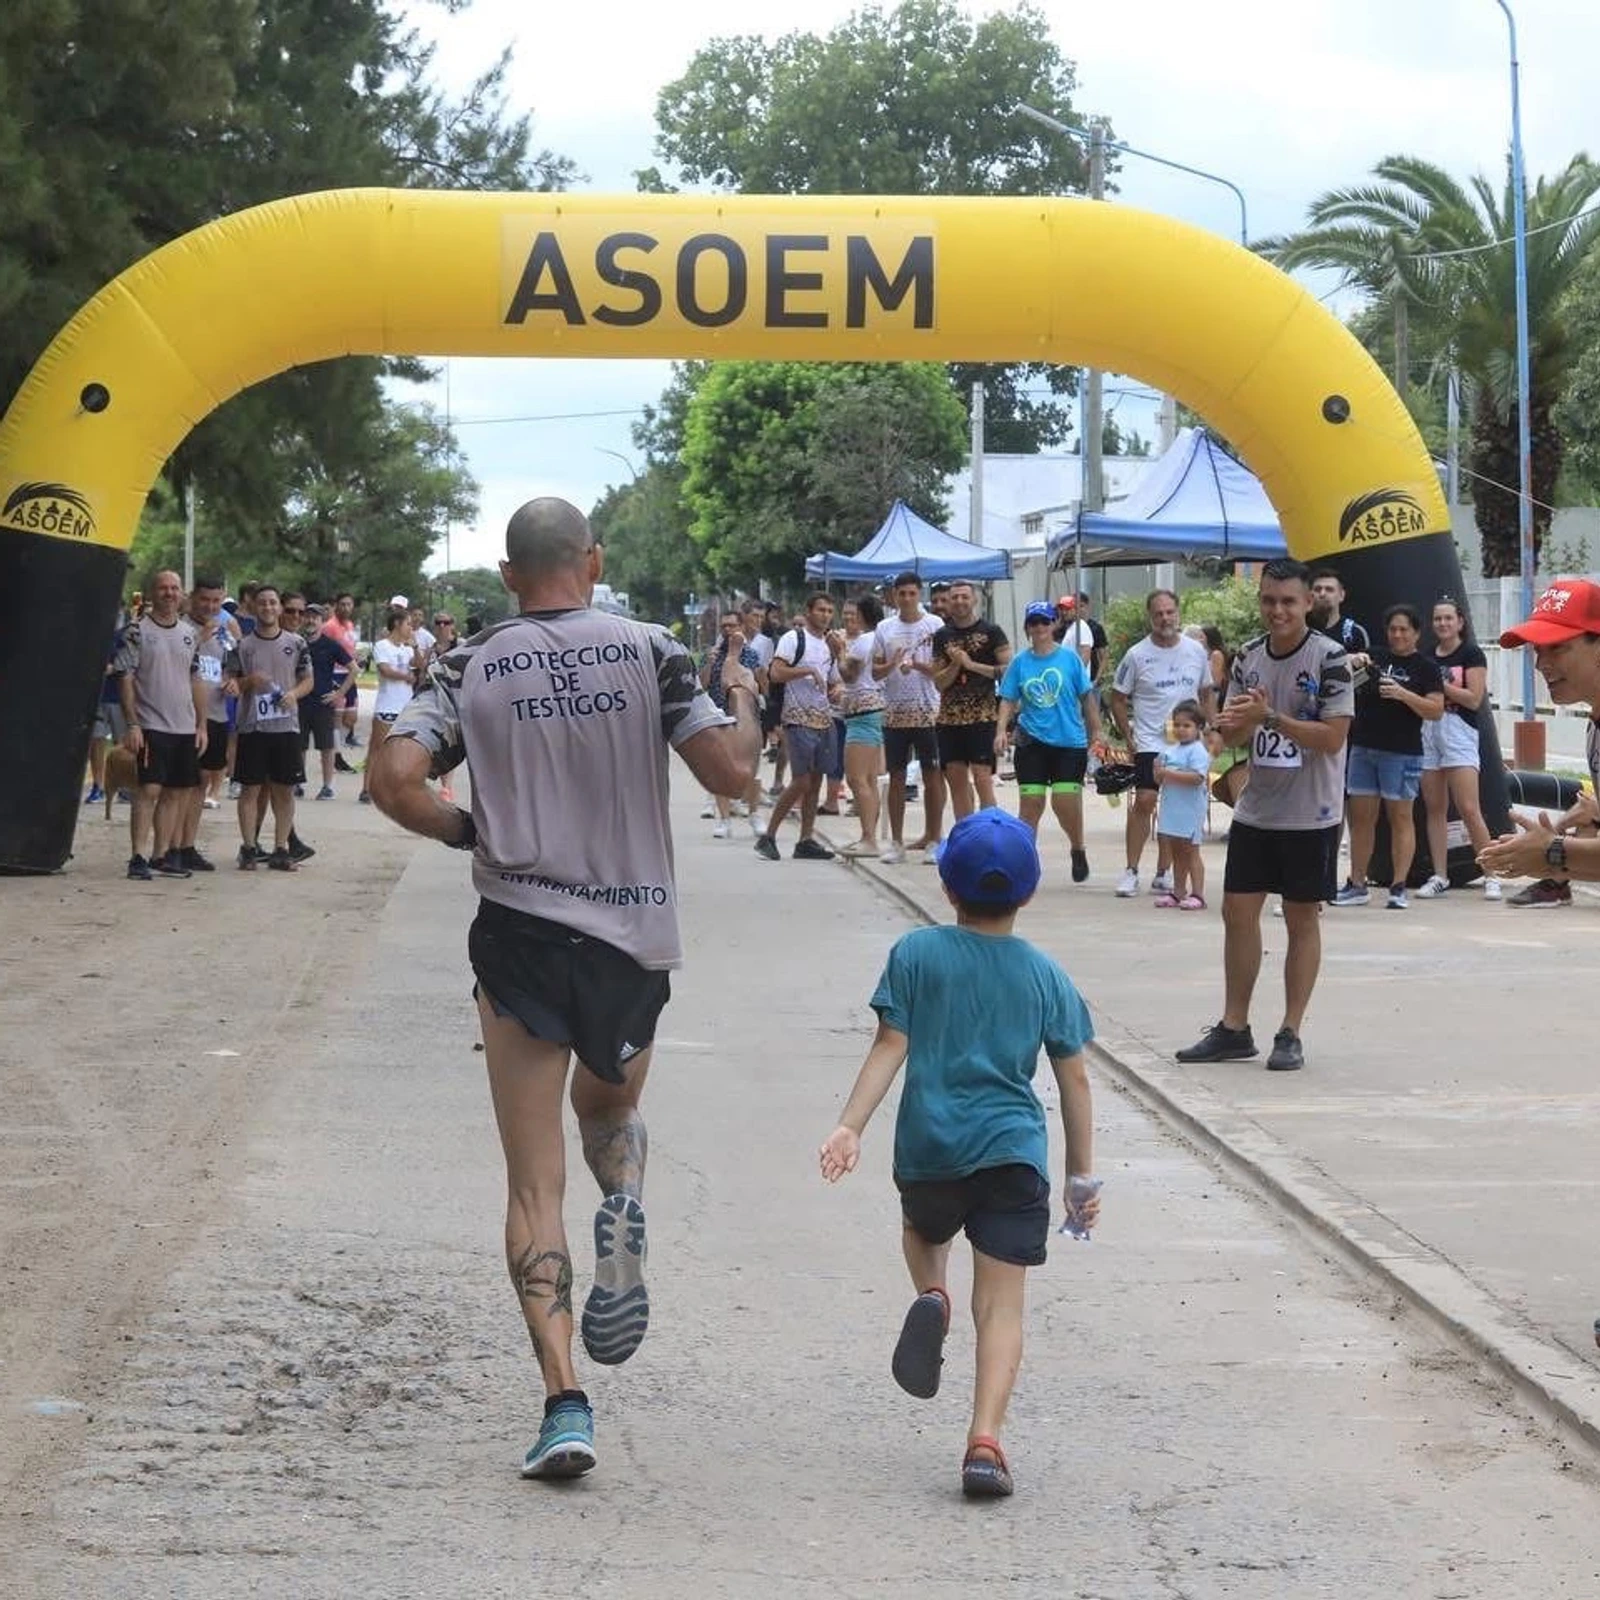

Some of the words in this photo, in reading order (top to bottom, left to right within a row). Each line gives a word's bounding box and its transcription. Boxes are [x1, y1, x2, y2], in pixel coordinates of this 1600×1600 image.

[503, 231, 934, 329] ASOEM
[10, 507, 91, 538] ASOEM
[1351, 512, 1425, 543] ASOEM
[483, 643, 640, 682] PROTECCION
[550, 672, 582, 693] DE
[511, 690, 628, 721] TESTIGOS
[1256, 731, 1299, 758] 023
